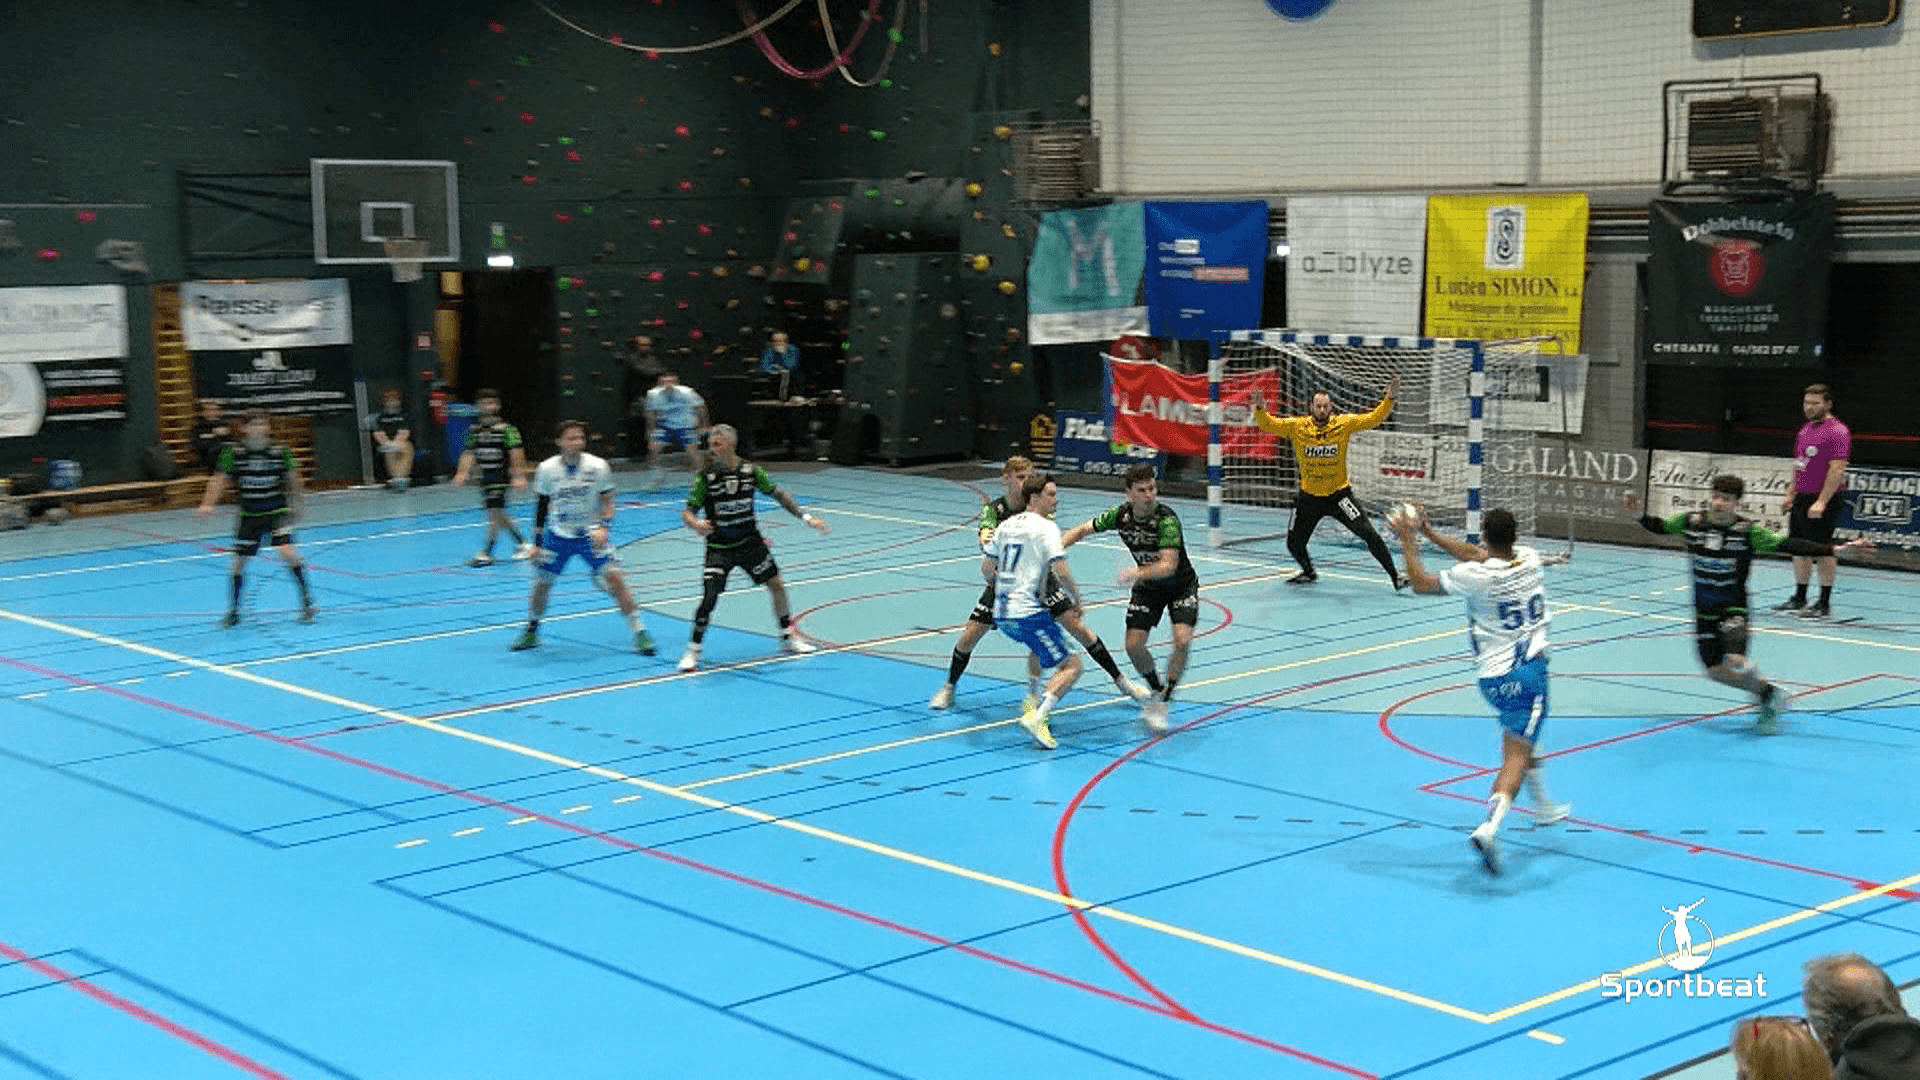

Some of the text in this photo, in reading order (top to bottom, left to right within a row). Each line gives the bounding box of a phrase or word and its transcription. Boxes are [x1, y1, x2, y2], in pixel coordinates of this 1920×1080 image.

[1434, 274, 1487, 295] Lucien
[1492, 276, 1560, 297] SIMON
[1652, 343, 1721, 354] CHERATTE
[1491, 443, 1639, 483] GALAND
[1002, 542, 1024, 573] 17
[1497, 592, 1545, 631] 50
